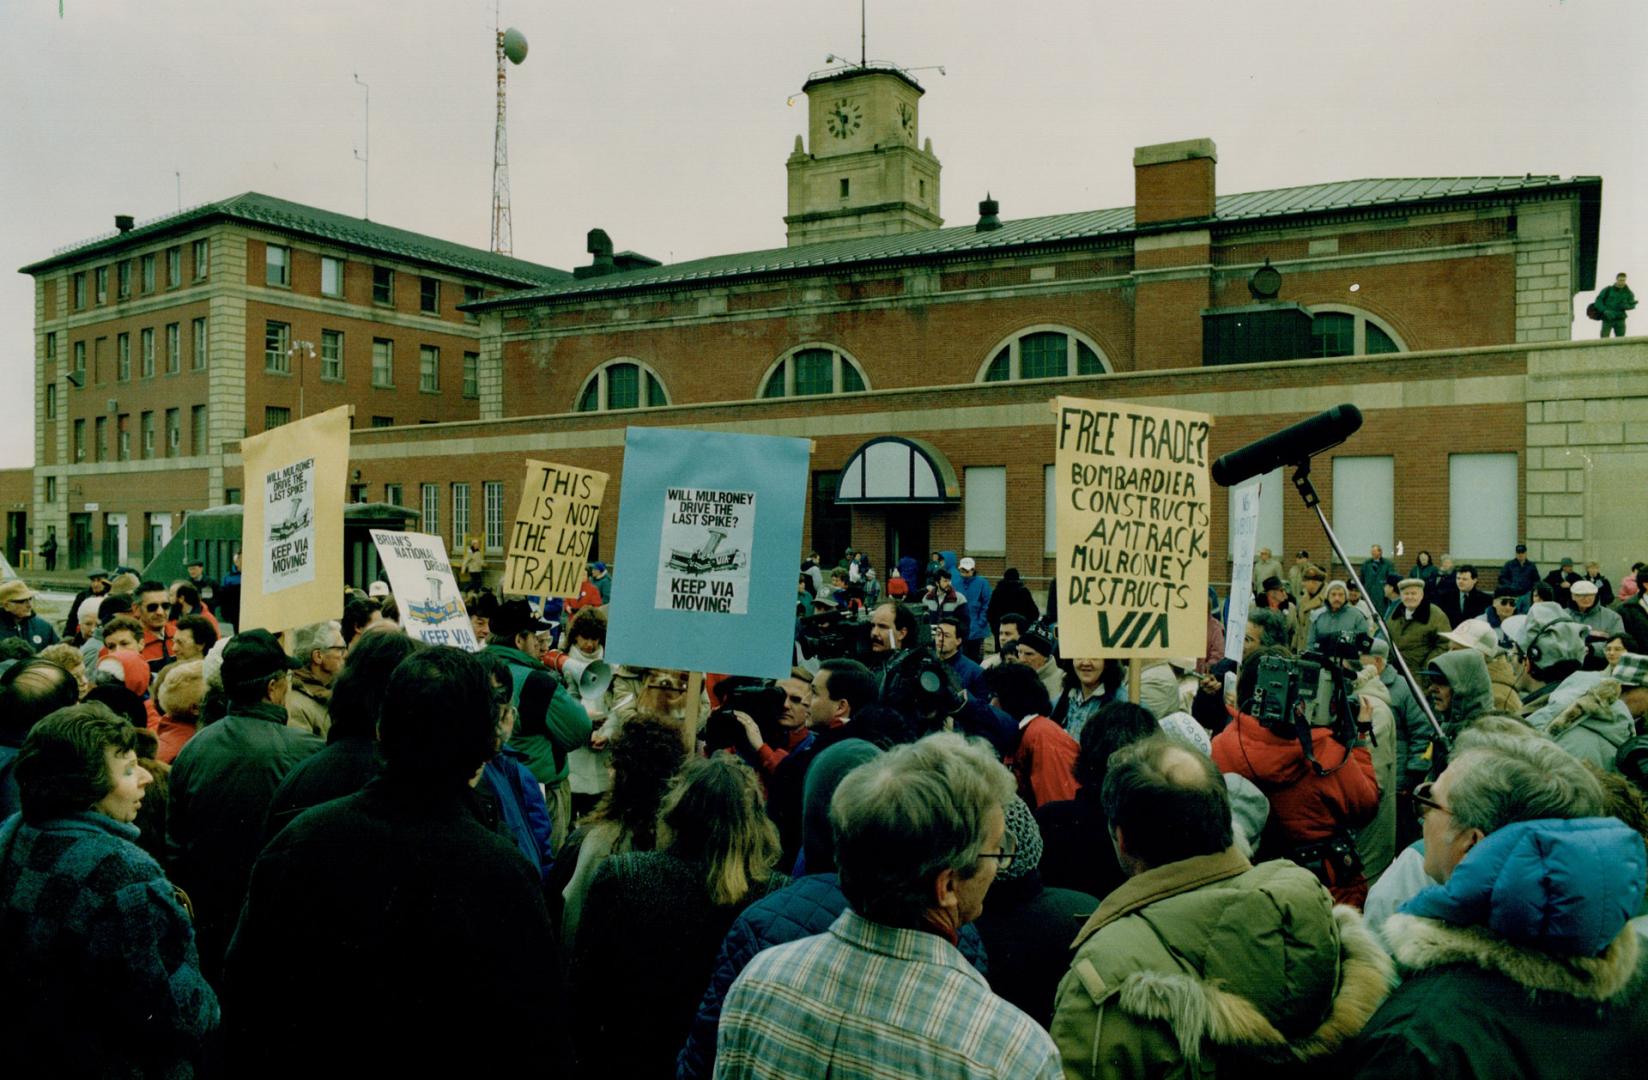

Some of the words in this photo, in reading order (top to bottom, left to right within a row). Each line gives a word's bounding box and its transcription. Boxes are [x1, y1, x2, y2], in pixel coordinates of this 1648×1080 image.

[1059, 407, 1119, 456] FREE
[1127, 413, 1210, 467] TRADE?
[266, 471, 281, 484] WILL
[282, 458, 315, 478] MULRONEY
[273, 477, 292, 492] DRIVE
[292, 471, 304, 485] THE
[542, 467, 593, 499] THIS
[1071, 462, 1196, 497] BOMBARDIER
[269, 490, 286, 503] LAST
[287, 480, 308, 497] SPIKE?
[668, 489, 692, 500] WILL
[695, 491, 754, 505] MULRONEY
[533, 496, 554, 521] IS
[565, 502, 599, 528] NOT
[679, 502, 710, 515] DRIVE
[714, 503, 734, 516] THE
[1071, 487, 1210, 527] CONSTRUCTS
[672, 513, 698, 526] LAST
[701, 515, 739, 529] SPIKE?
[271, 542, 292, 561] KEEP
[294, 538, 308, 553] VIA
[375, 533, 413, 548] BRIAN'S
[515, 521, 551, 553] THE
[556, 528, 594, 558] LAST
[1085, 518, 1209, 559] AMTRACK.
[272, 552, 307, 574] MOVING!
[394, 547, 436, 560] NATIONAL
[1071, 544, 1192, 581] MULRONEY
[509, 553, 582, 593] TRAIN
[671, 577, 707, 595] KEEP
[711, 580, 734, 598] VIA
[1069, 575, 1191, 612] DESTRUCTS
[672, 594, 731, 614] MOVING!
[420, 629, 449, 645] KEEP
[451, 630, 472, 645] VIA
[1097, 610, 1170, 648] VIA
